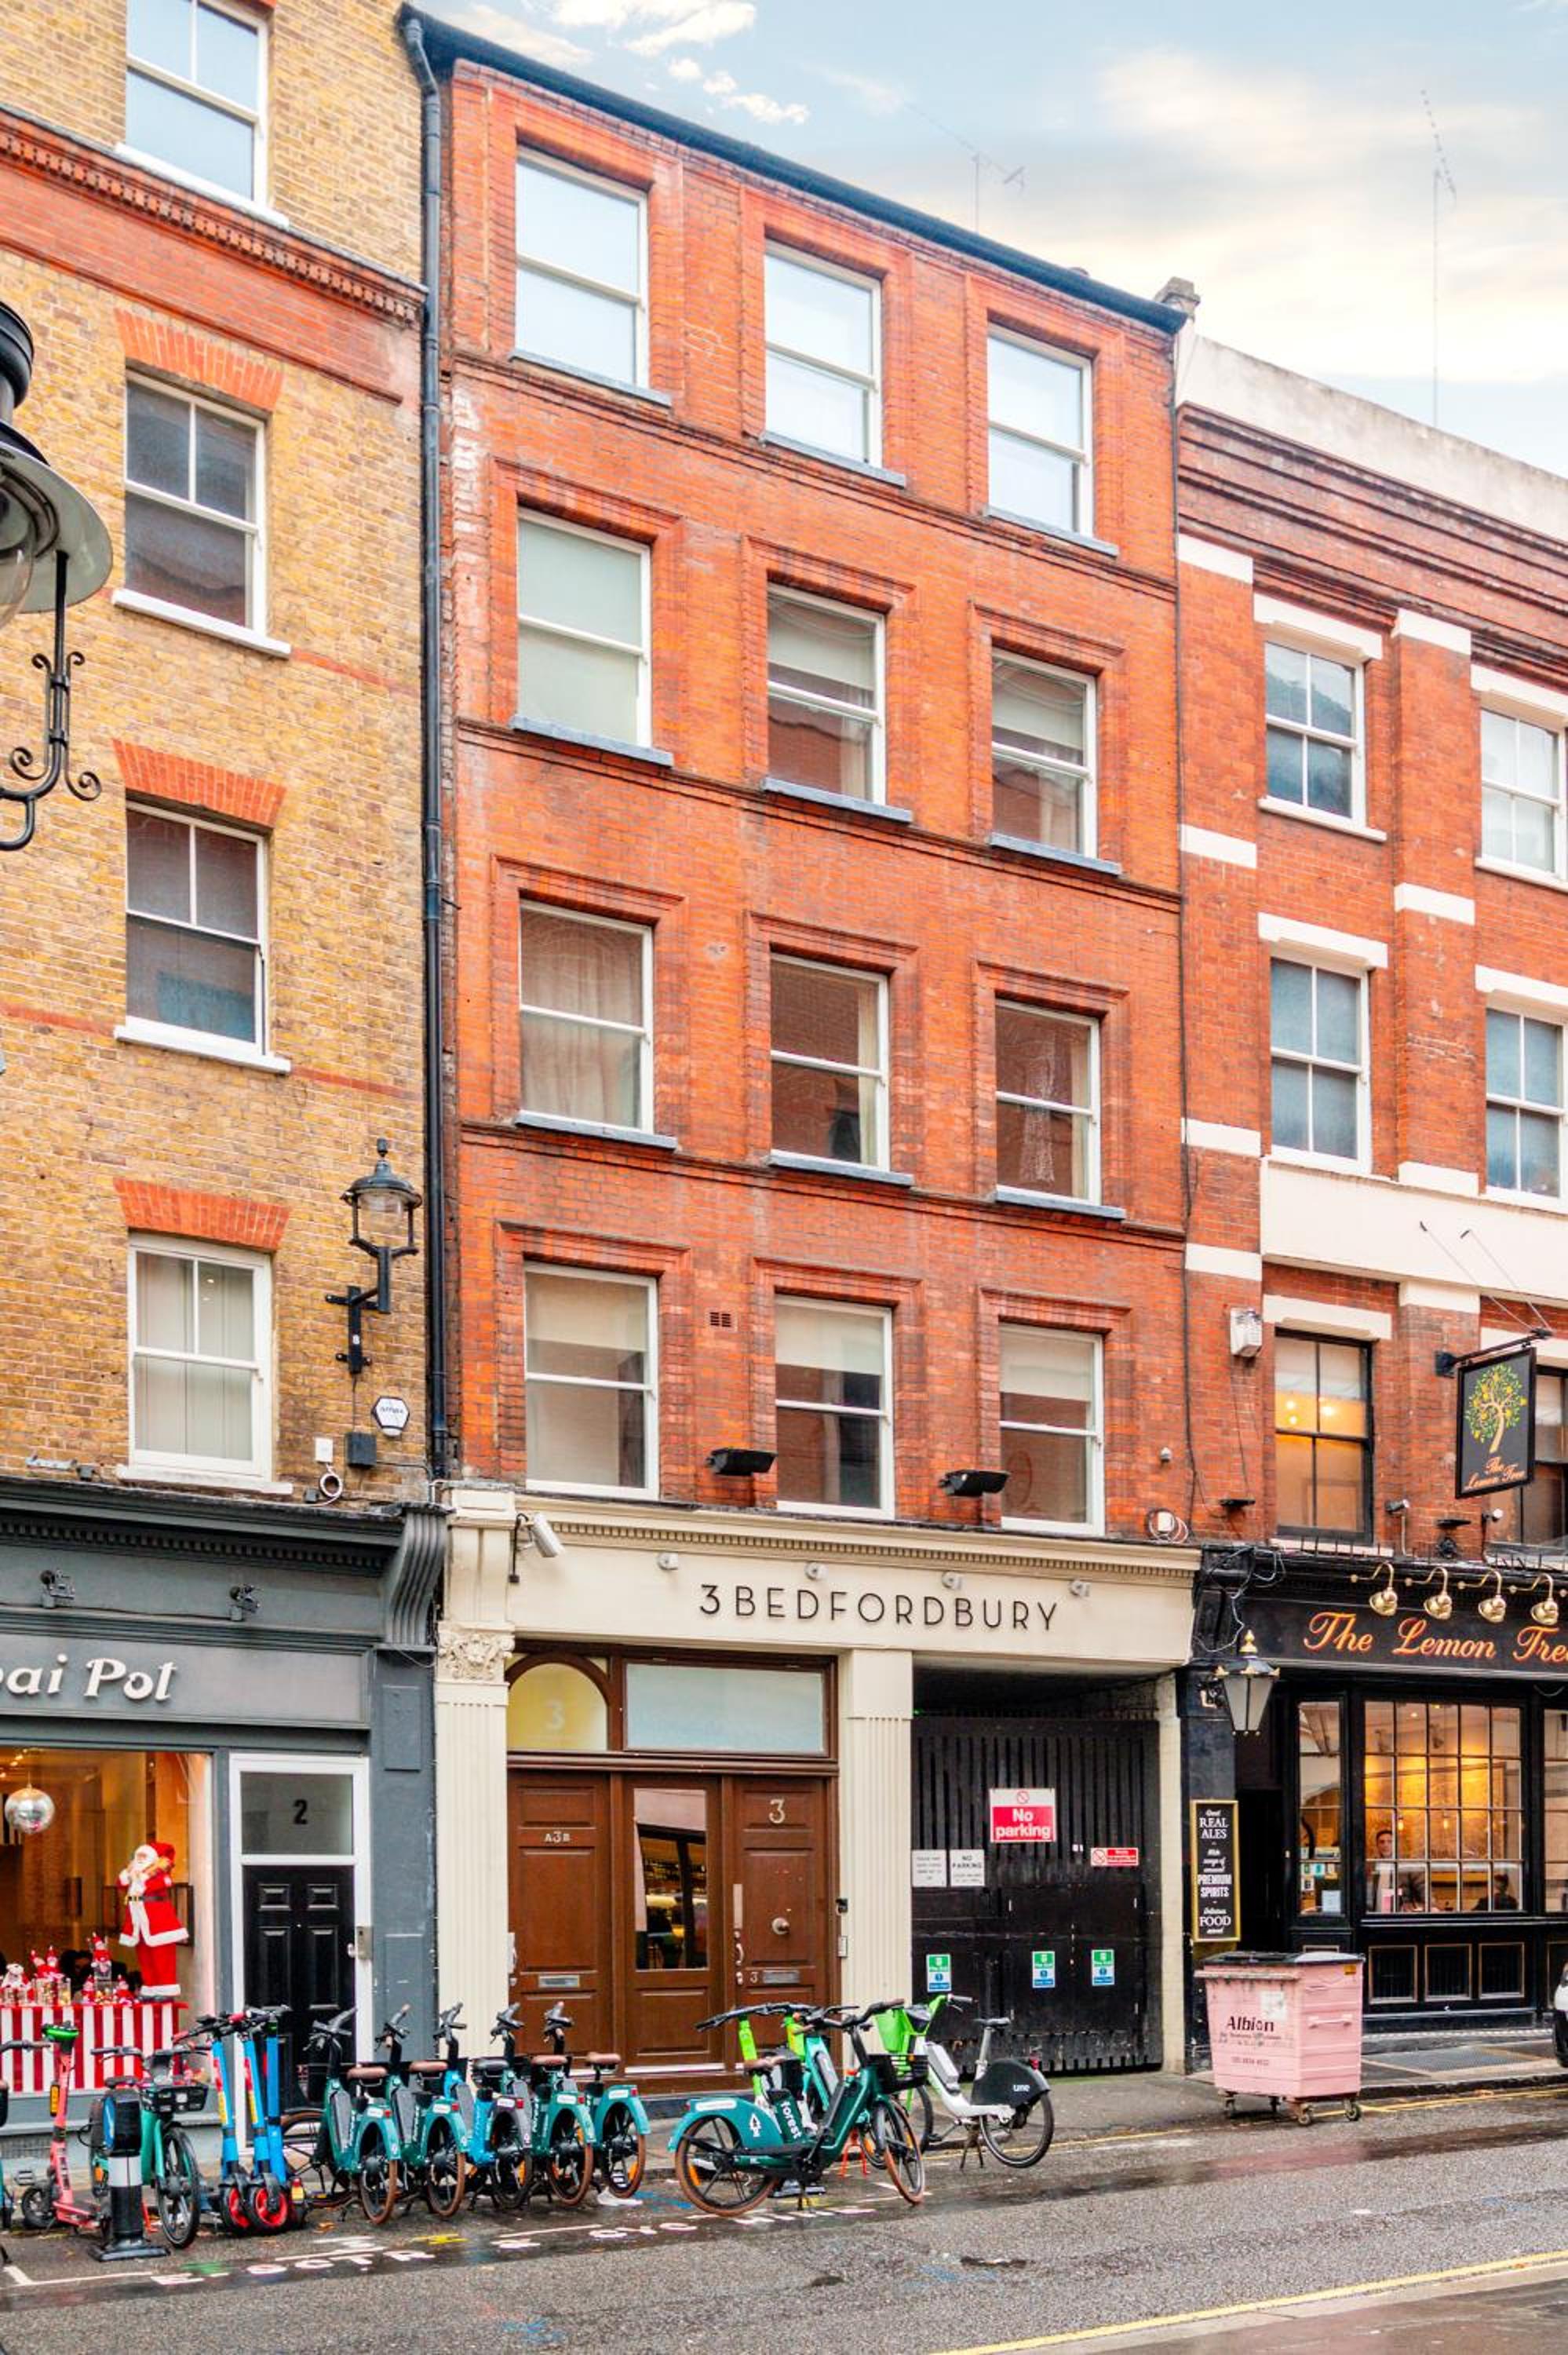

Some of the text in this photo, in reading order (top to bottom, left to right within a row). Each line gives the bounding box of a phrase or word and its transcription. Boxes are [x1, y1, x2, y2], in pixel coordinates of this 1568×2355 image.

[735, 1586, 1057, 1630] BEDFORDBURY
[1304, 1612, 1568, 1663] The Lemon Tre
[83, 1658, 177, 1701] Pot
[294, 1799, 308, 1825] 2
[769, 1798, 786, 1824] 3
[1012, 1808, 1034, 1822] No
[1199, 1817, 1230, 1828] REAL
[996, 1824, 1051, 1839] parking
[1202, 1828, 1227, 1839] ALES
[1198, 1874, 1232, 1885] PREMIUM
[1200, 1886, 1230, 1897] SPIRITS
[1199, 1915, 1231, 1927] FOOD
[749, 1971, 759, 1983] 3
[1227, 2016, 1274, 2032] Albion
[780, 2101, 802, 2139] forest
